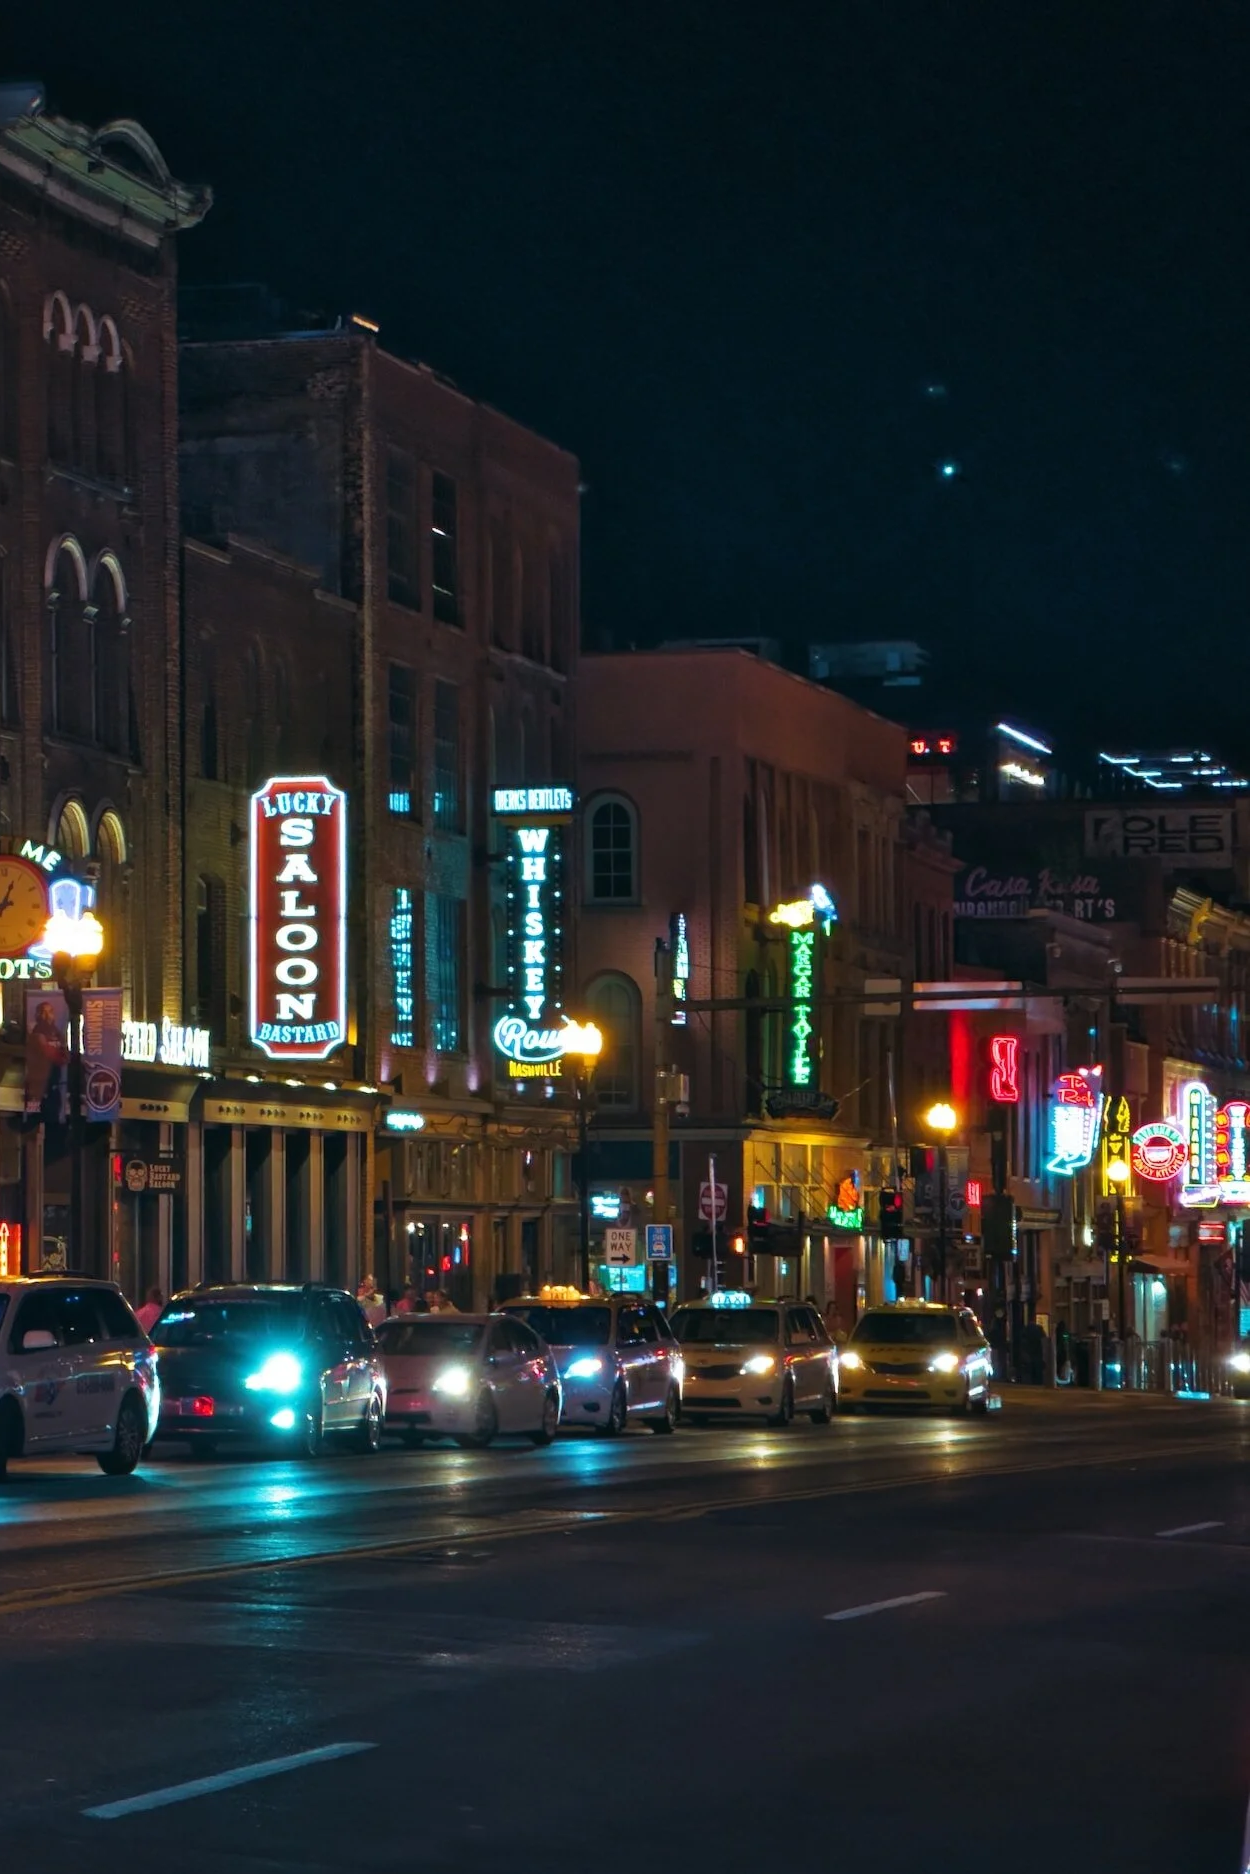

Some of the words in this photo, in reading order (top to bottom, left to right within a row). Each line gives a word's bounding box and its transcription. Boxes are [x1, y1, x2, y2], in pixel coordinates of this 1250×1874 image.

[261, 792, 337, 817] LUCKY
[494, 789, 527, 811] DIERKS
[1122, 815, 1224, 834] OLE
[1123, 835, 1225, 854] RED
[965, 866, 1032, 898] Casa
[275, 818, 319, 1021] SALOON
[516, 829, 550, 1020] WHISKEY
[792, 931, 814, 1084] MARGARTAVILLE
[87, 1000, 104, 1056] SIMMONS
[260, 1021, 340, 1044] BASTARD
[509, 1059, 562, 1077] NASHVILLE
[1059, 1075, 1088, 1089] Tin
[1057, 1088, 1094, 1108] Roof
[1132, 1152, 1154, 1178] CANDY
[1155, 1151, 1186, 1178] KITCHEN
[610, 1242, 632, 1251] WAY
[611, 1231, 631, 1241] ONE
[716, 1294, 748, 1306] TAXI
